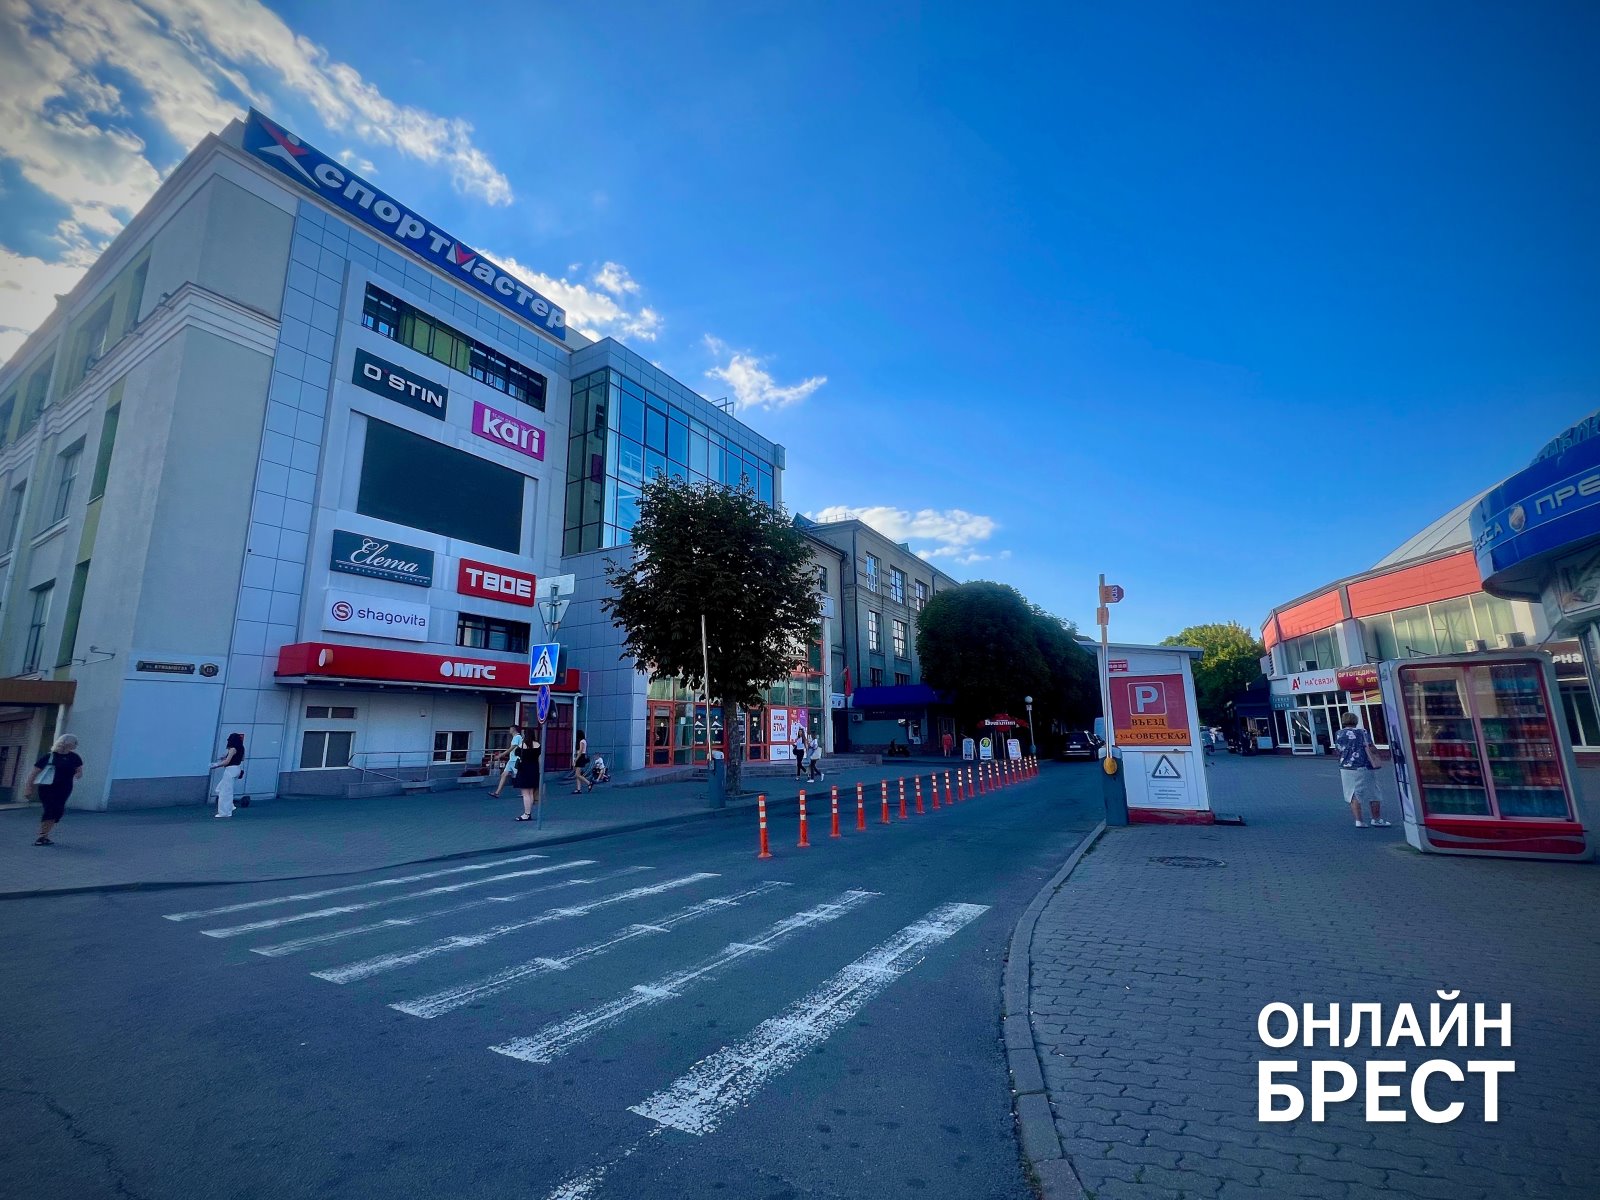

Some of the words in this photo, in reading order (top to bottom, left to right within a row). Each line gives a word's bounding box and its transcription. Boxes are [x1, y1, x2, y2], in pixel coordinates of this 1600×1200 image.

[482, 408, 540, 454] kari
[350, 538, 420, 574] Elema
[465, 567, 532, 598] ТВОЕ
[357, 607, 427, 626] shagovita
[453, 662, 497, 680] МТС
[1135, 685, 1159, 713] P
[1131, 718, 1166, 727] ВЪЕЗД
